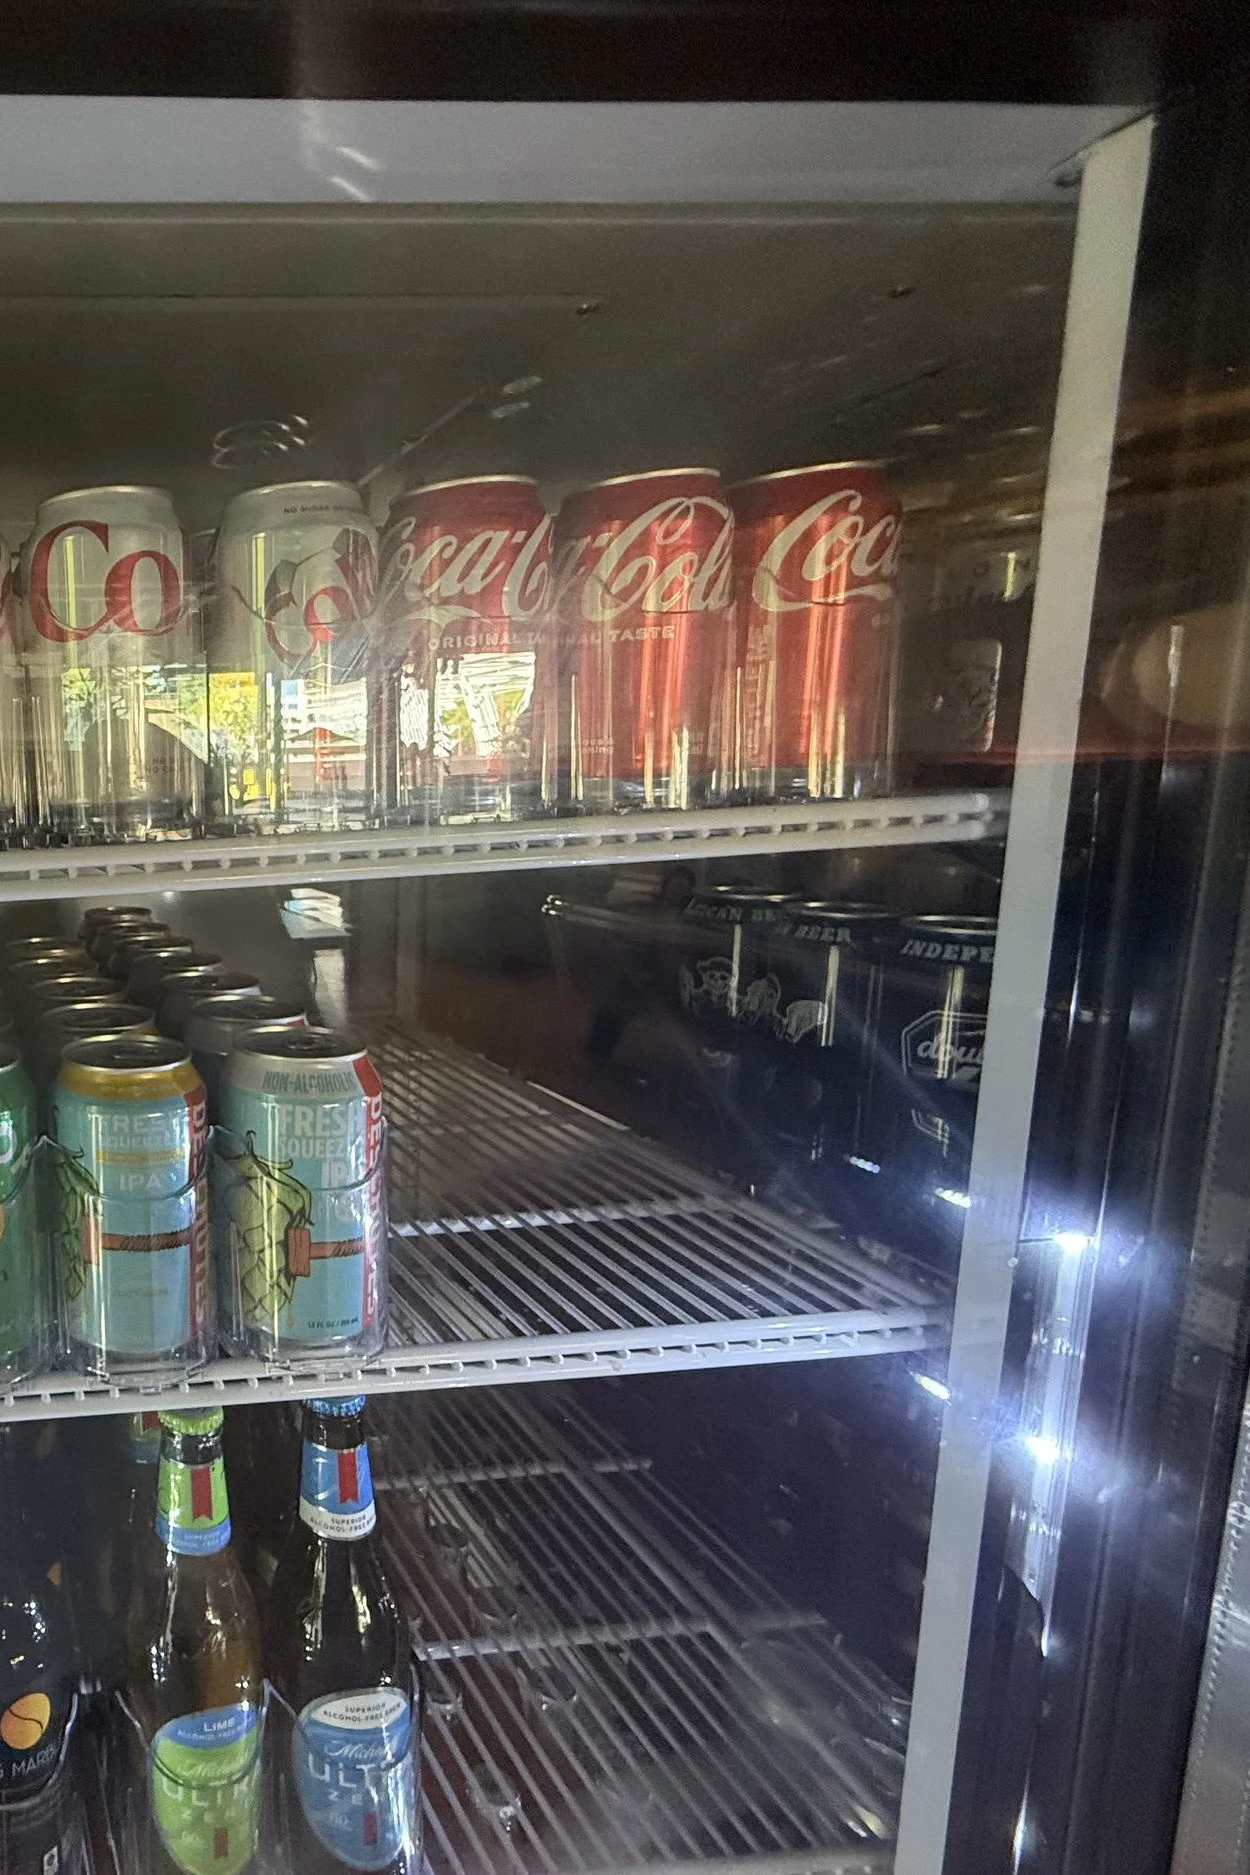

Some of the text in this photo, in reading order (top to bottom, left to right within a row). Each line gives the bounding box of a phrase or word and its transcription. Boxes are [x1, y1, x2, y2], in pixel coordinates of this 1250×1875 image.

[428, 630, 522, 649] ORIGINAL
[608, 625, 677, 642] TASTE
[119, 1172, 163, 1192] IPA
[322, 1709, 363, 1723] ALCOHOL
[203, 1717, 236, 1733] LIME
